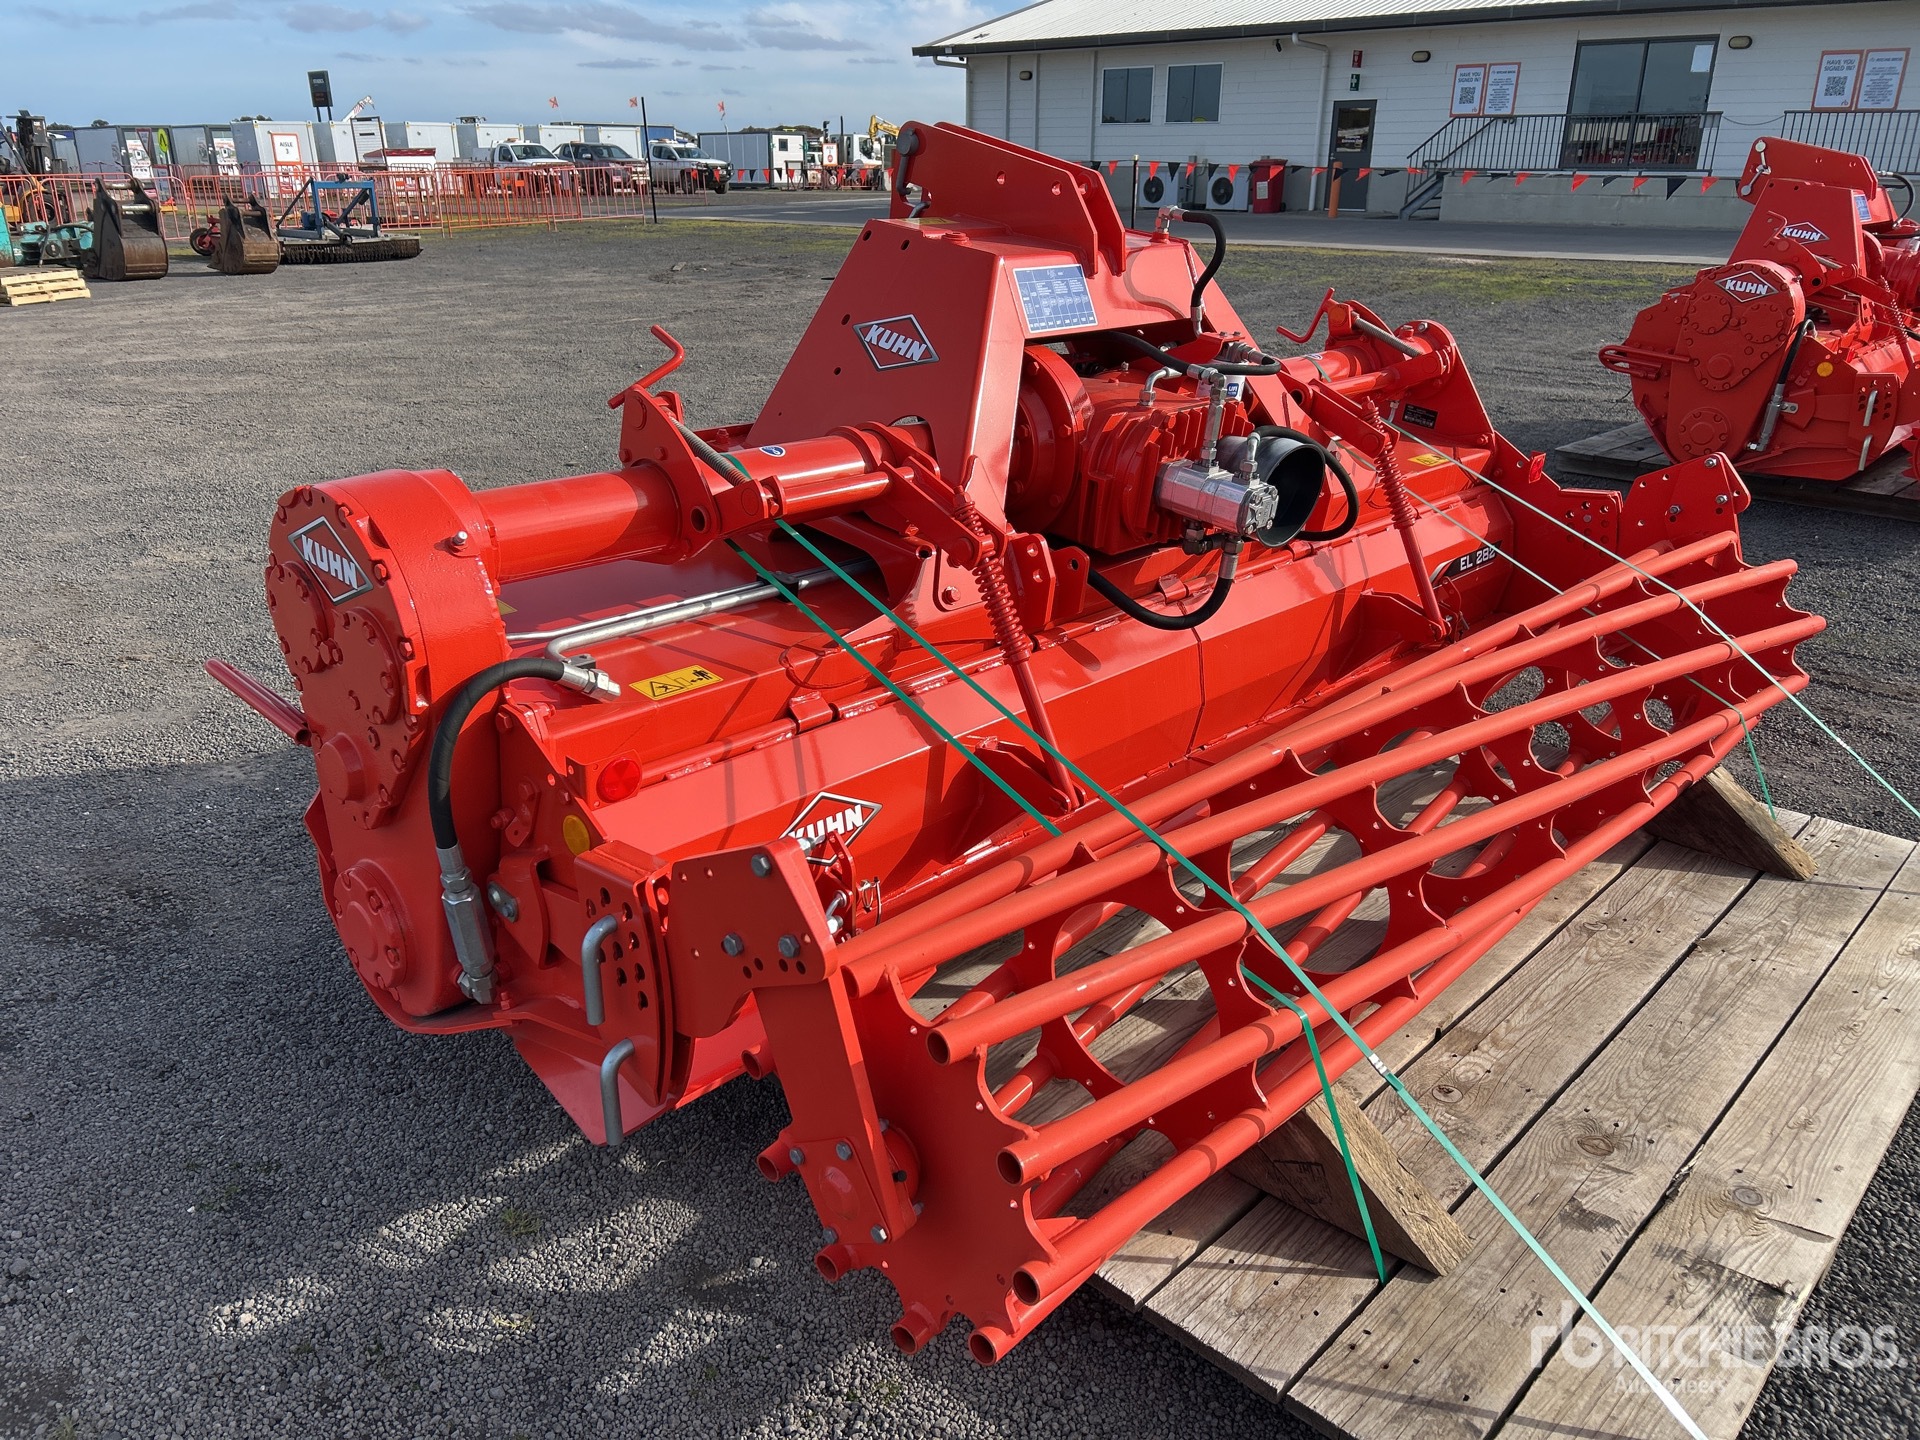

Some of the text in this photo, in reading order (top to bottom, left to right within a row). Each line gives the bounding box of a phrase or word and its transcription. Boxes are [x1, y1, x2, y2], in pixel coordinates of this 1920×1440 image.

[1782, 226, 1821, 241] KUHN
[1725, 279, 1768, 295] KUHN
[864, 323, 927, 362] KUHN
[301, 533, 358, 590] KUHN
[1460, 547, 1496, 571] EL 282
